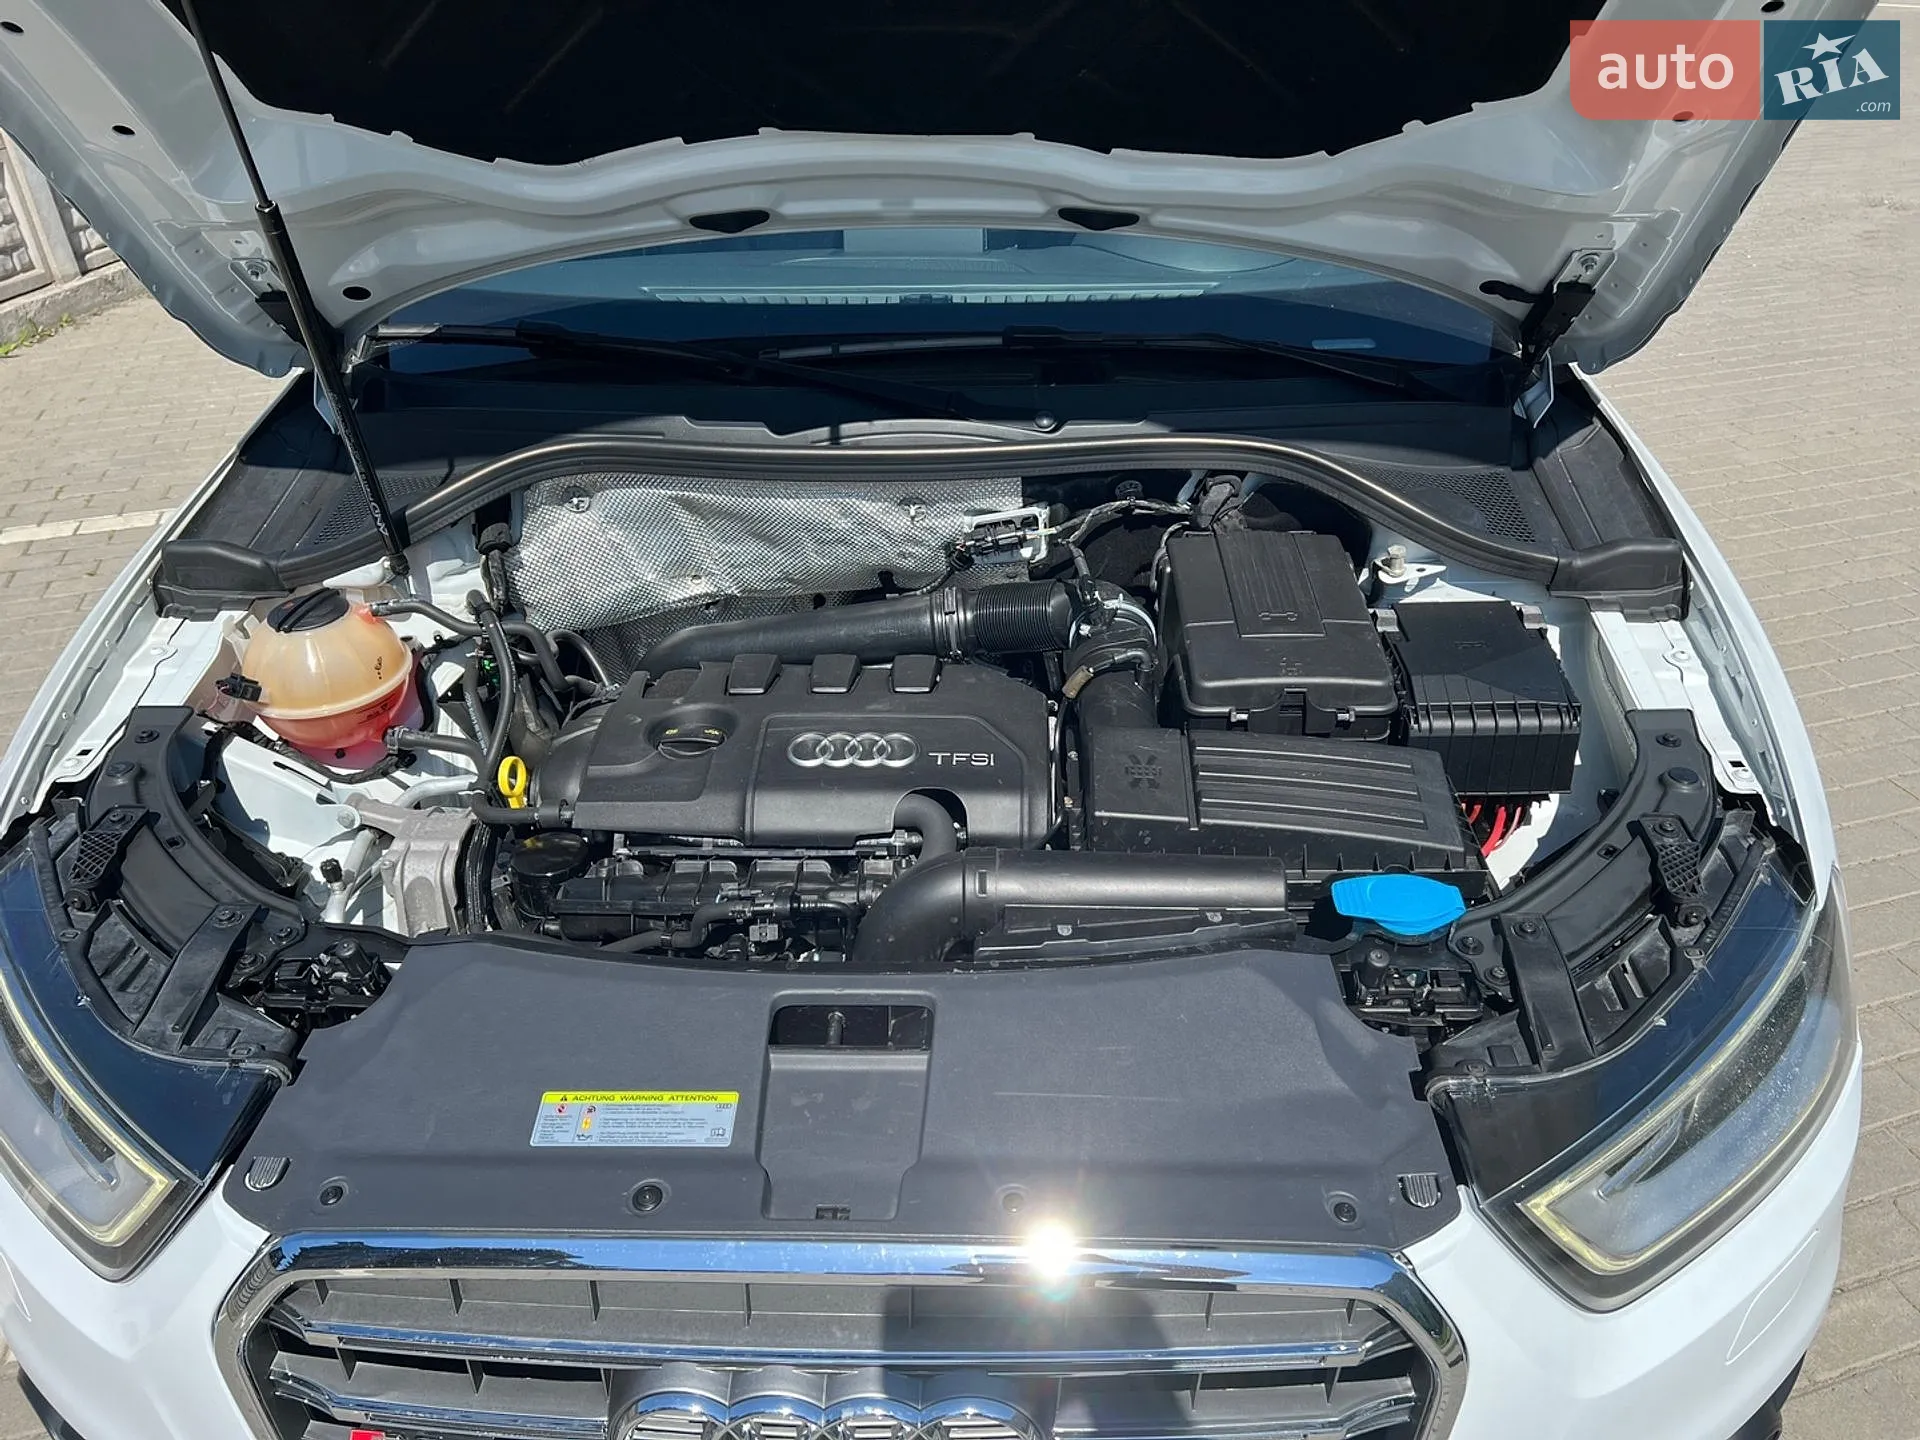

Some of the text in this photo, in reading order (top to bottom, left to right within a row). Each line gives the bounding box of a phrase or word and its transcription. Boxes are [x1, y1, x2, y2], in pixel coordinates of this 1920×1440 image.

[927, 752, 995, 766] TFSI
[572, 1094, 719, 1102] ACHTUNG WARNING ATTENTION
